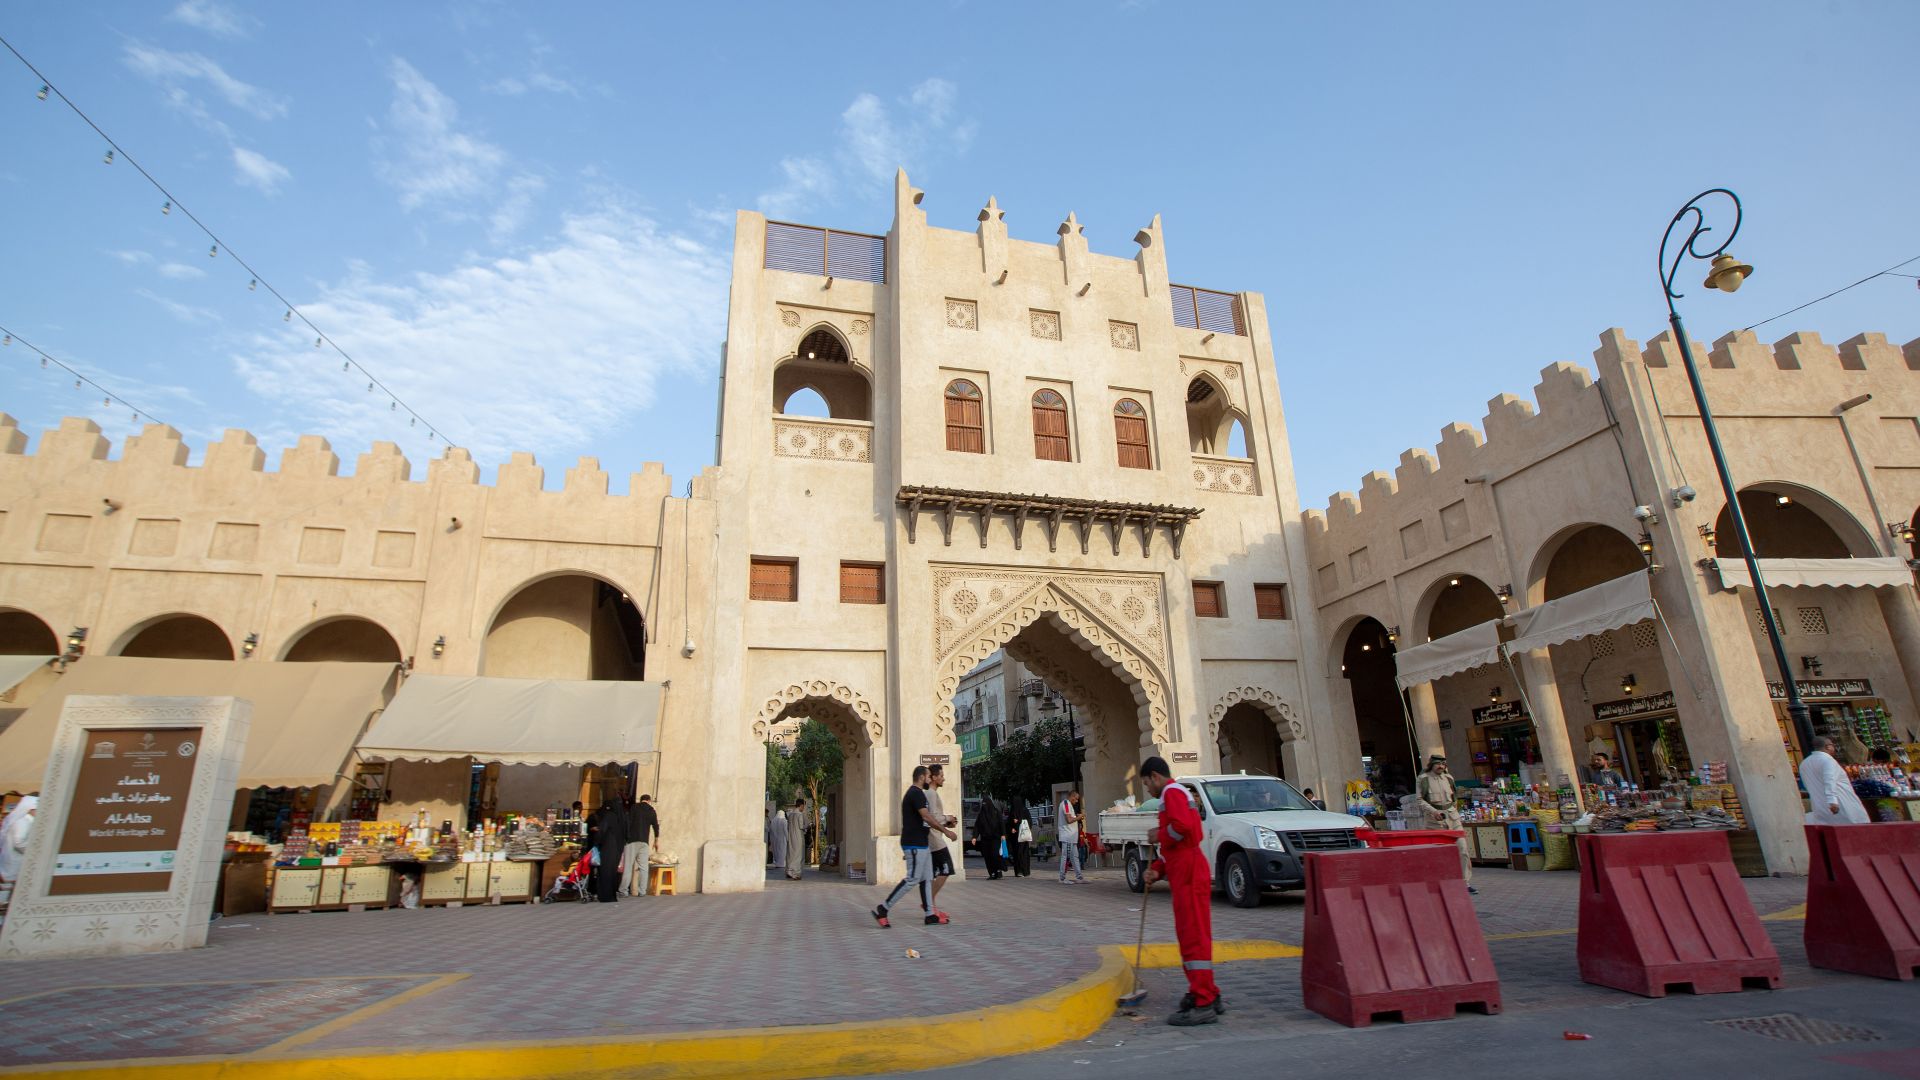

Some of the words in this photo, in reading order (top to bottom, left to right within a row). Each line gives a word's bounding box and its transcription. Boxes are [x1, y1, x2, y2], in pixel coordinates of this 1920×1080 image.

[117, 772, 160, 786] الأحساء
[96, 792, 126, 805] عالمي
[126, 791, 147, 804] تراث
[146, 792, 171, 804] موقع
[104, 813, 152, 824] Al-Ahsa
[88, 829, 114, 837] World
[115, 828, 150, 837] Heritage
[150, 827, 166, 836] Site
